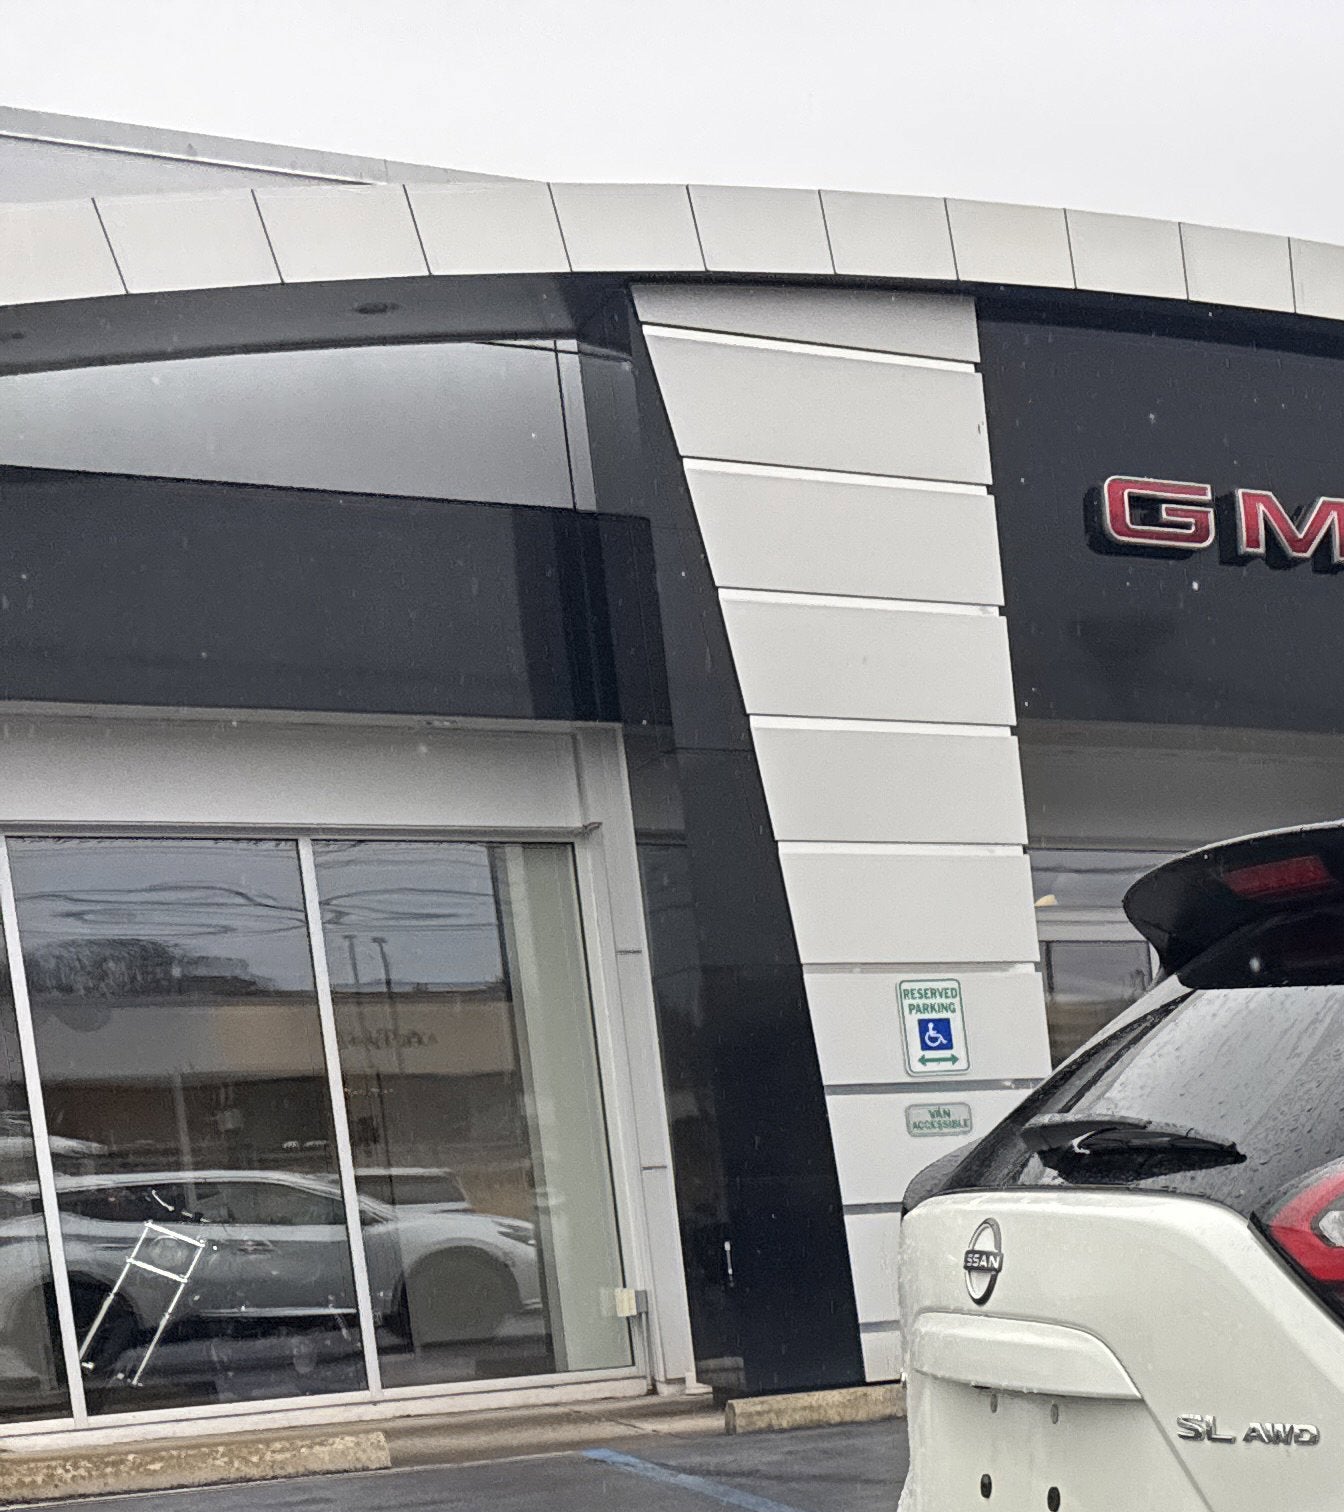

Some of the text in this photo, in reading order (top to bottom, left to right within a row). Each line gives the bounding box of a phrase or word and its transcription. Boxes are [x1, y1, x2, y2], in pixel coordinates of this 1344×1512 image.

[903, 987, 958, 1000] RESERVED
[908, 1002, 956, 1015] PARKING
[928, 1108, 951, 1119] VAN
[912, 1119, 970, 1131] ACCESSIBLE
[1176, 1413, 1321, 1446] SL AWD
